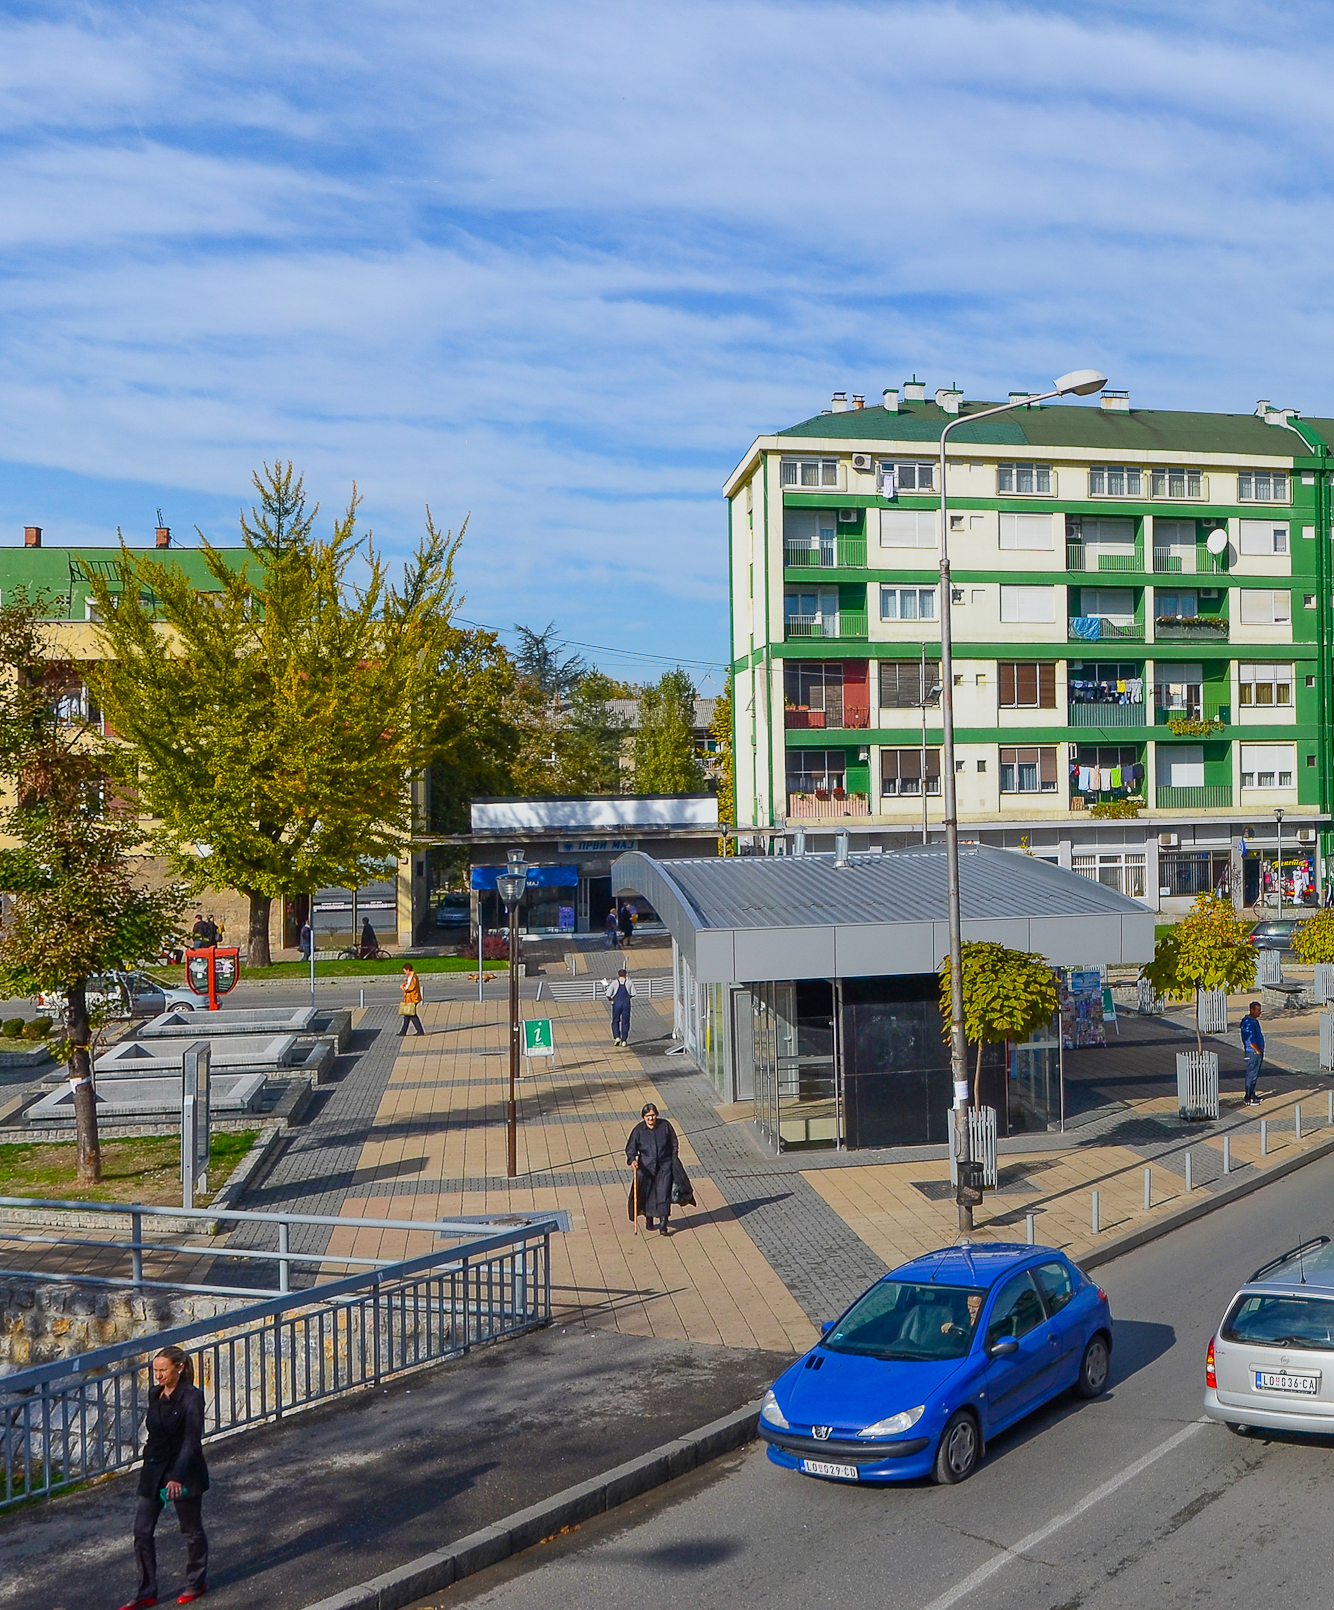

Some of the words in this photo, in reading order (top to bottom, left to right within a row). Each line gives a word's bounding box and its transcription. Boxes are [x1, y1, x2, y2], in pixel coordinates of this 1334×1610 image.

[578, 841, 607, 850] ПРВИ
[612, 840, 634, 850] МАЈ
[1263, 1375, 1274, 1386] LO
[806, 1461, 818, 1472] LO
